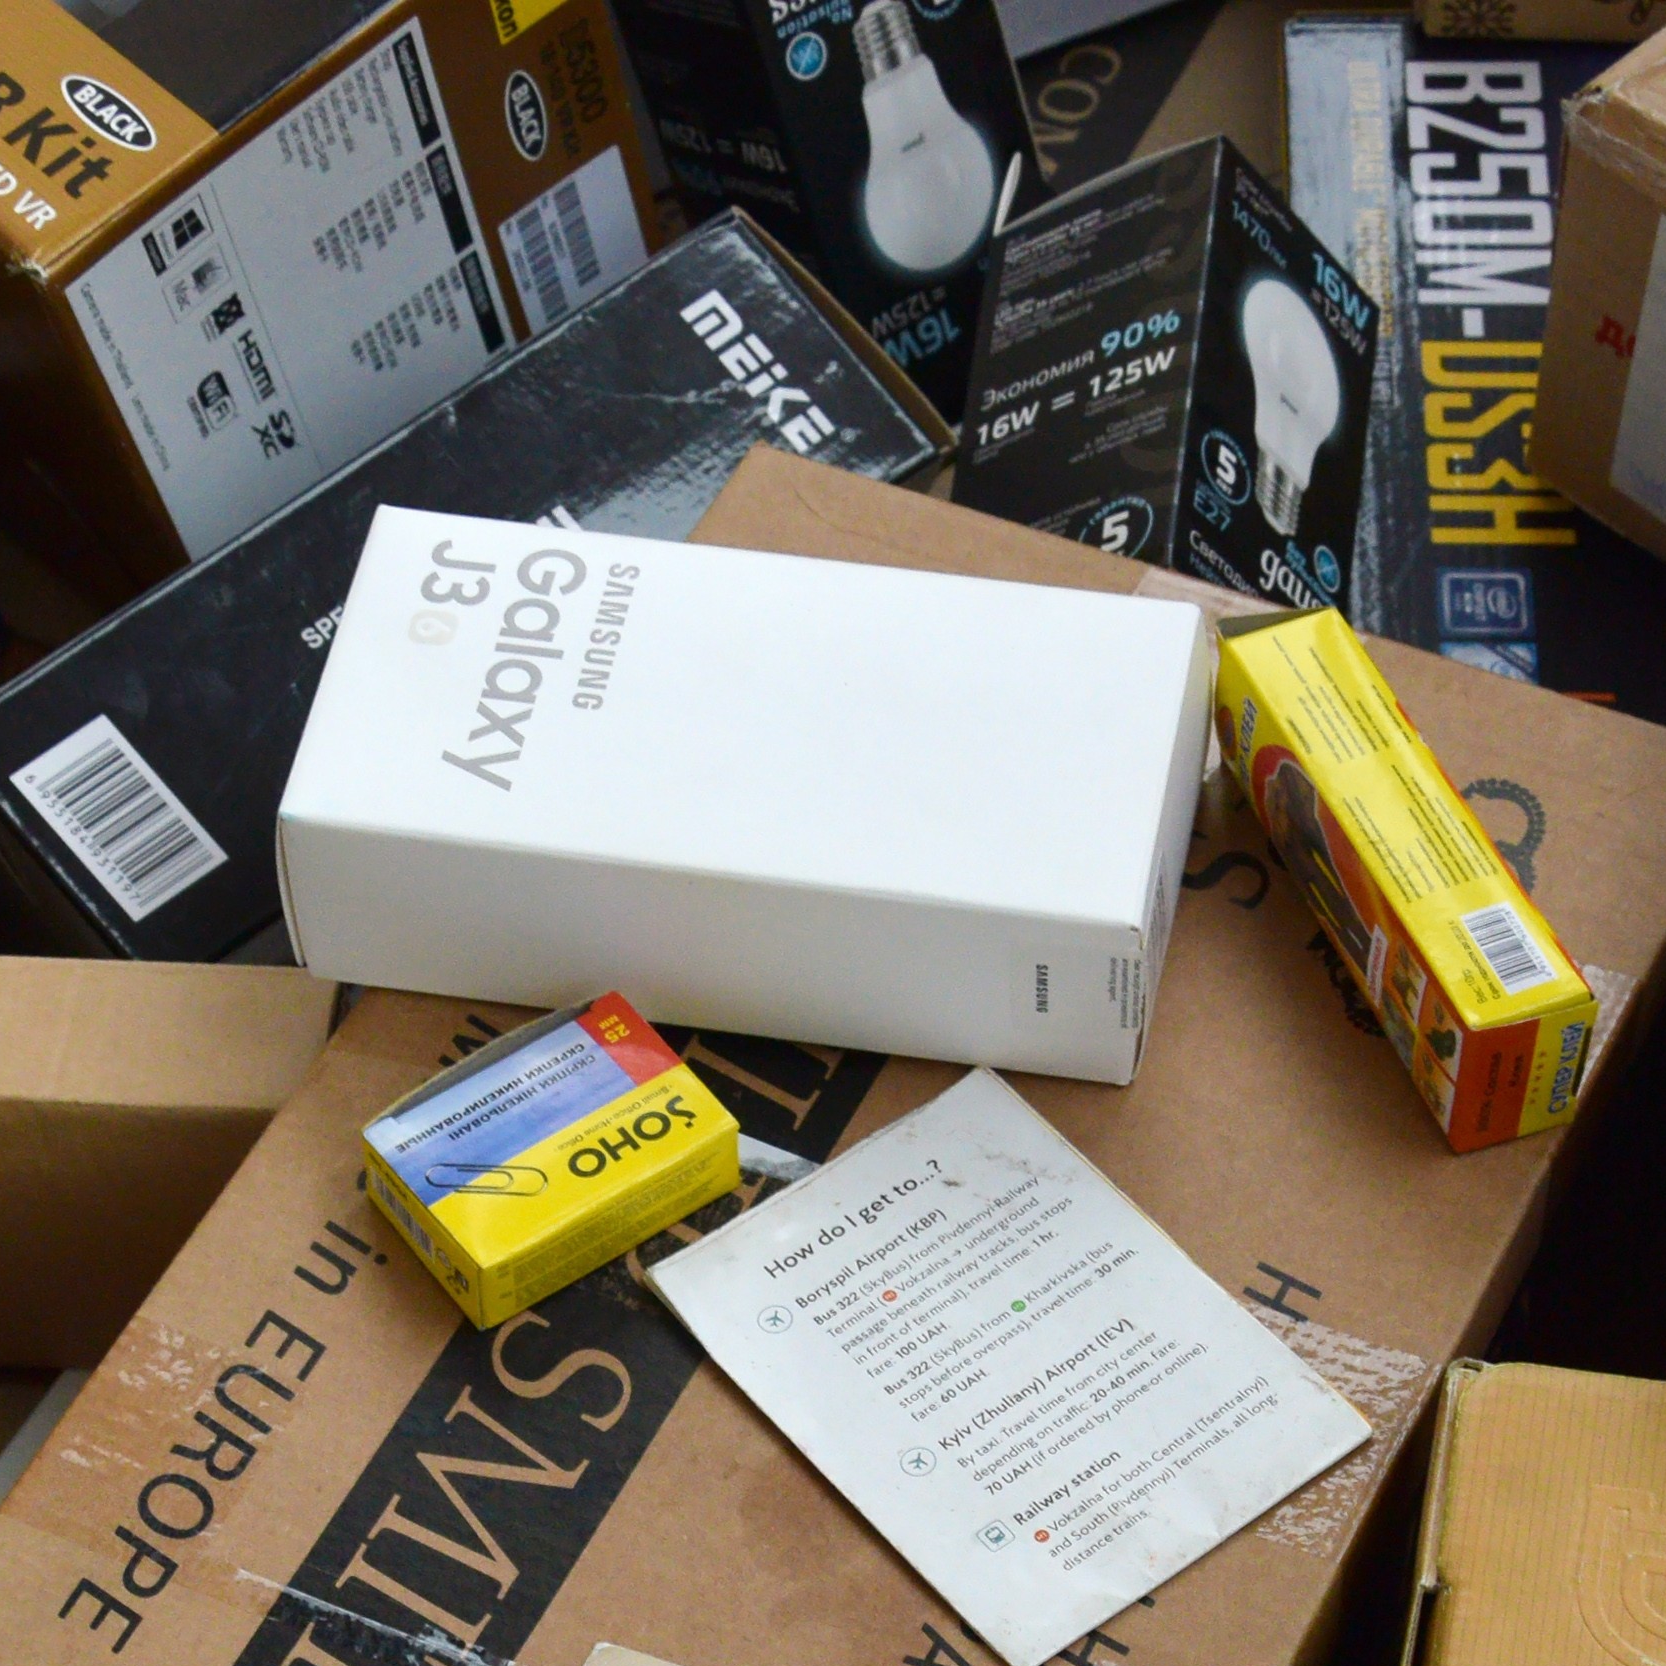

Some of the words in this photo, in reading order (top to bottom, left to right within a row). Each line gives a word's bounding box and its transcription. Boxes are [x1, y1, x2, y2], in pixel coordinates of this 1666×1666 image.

[4, 108, 117, 202] Kit
[72, 83, 144, 144] BLACK
[13, 191, 58, 232] VR
[1101, 308, 1181, 359] 90%
[976, 399, 1040, 447] 16W
[1088, 346, 1177, 398] 125W
[419, 538, 496, 608] J3
[441, 548, 588, 792] Galaxy
[571, 562, 640, 711] SAMSUNG
[1034, 963, 1051, 1014] SAMSUNG
[605, 1024, 631, 1045] 25
[568, 1092, 698, 1179] SOHO
[295, 1220, 391, 1300] in
[762, 1242, 814, 1279] How
[817, 1224, 846, 1246] do
[857, 1193, 894, 1225] get
[793, 1265, 855, 1309] Boryspil
[854, 1233, 907, 1272] Airport
[904, 1207, 947, 1239] (KBP)
[897, 1383, 933, 1409] stops
[928, 1356, 972, 1387] before
[1029, 1293, 1067, 1322] travel
[1093, 1262, 1112, 1278] 30
[1110, 1248, 1139, 1268] min.
[937, 1424, 972, 1451] Kyiv
[1044, 1342, 1097, 1382] Airport
[1094, 1317, 1134, 1349] (IEV)
[58, 1309, 328, 1656] EUROPE
[1011, 1483, 1071, 1526] Railway
[1070, 1450, 1121, 1487] station
